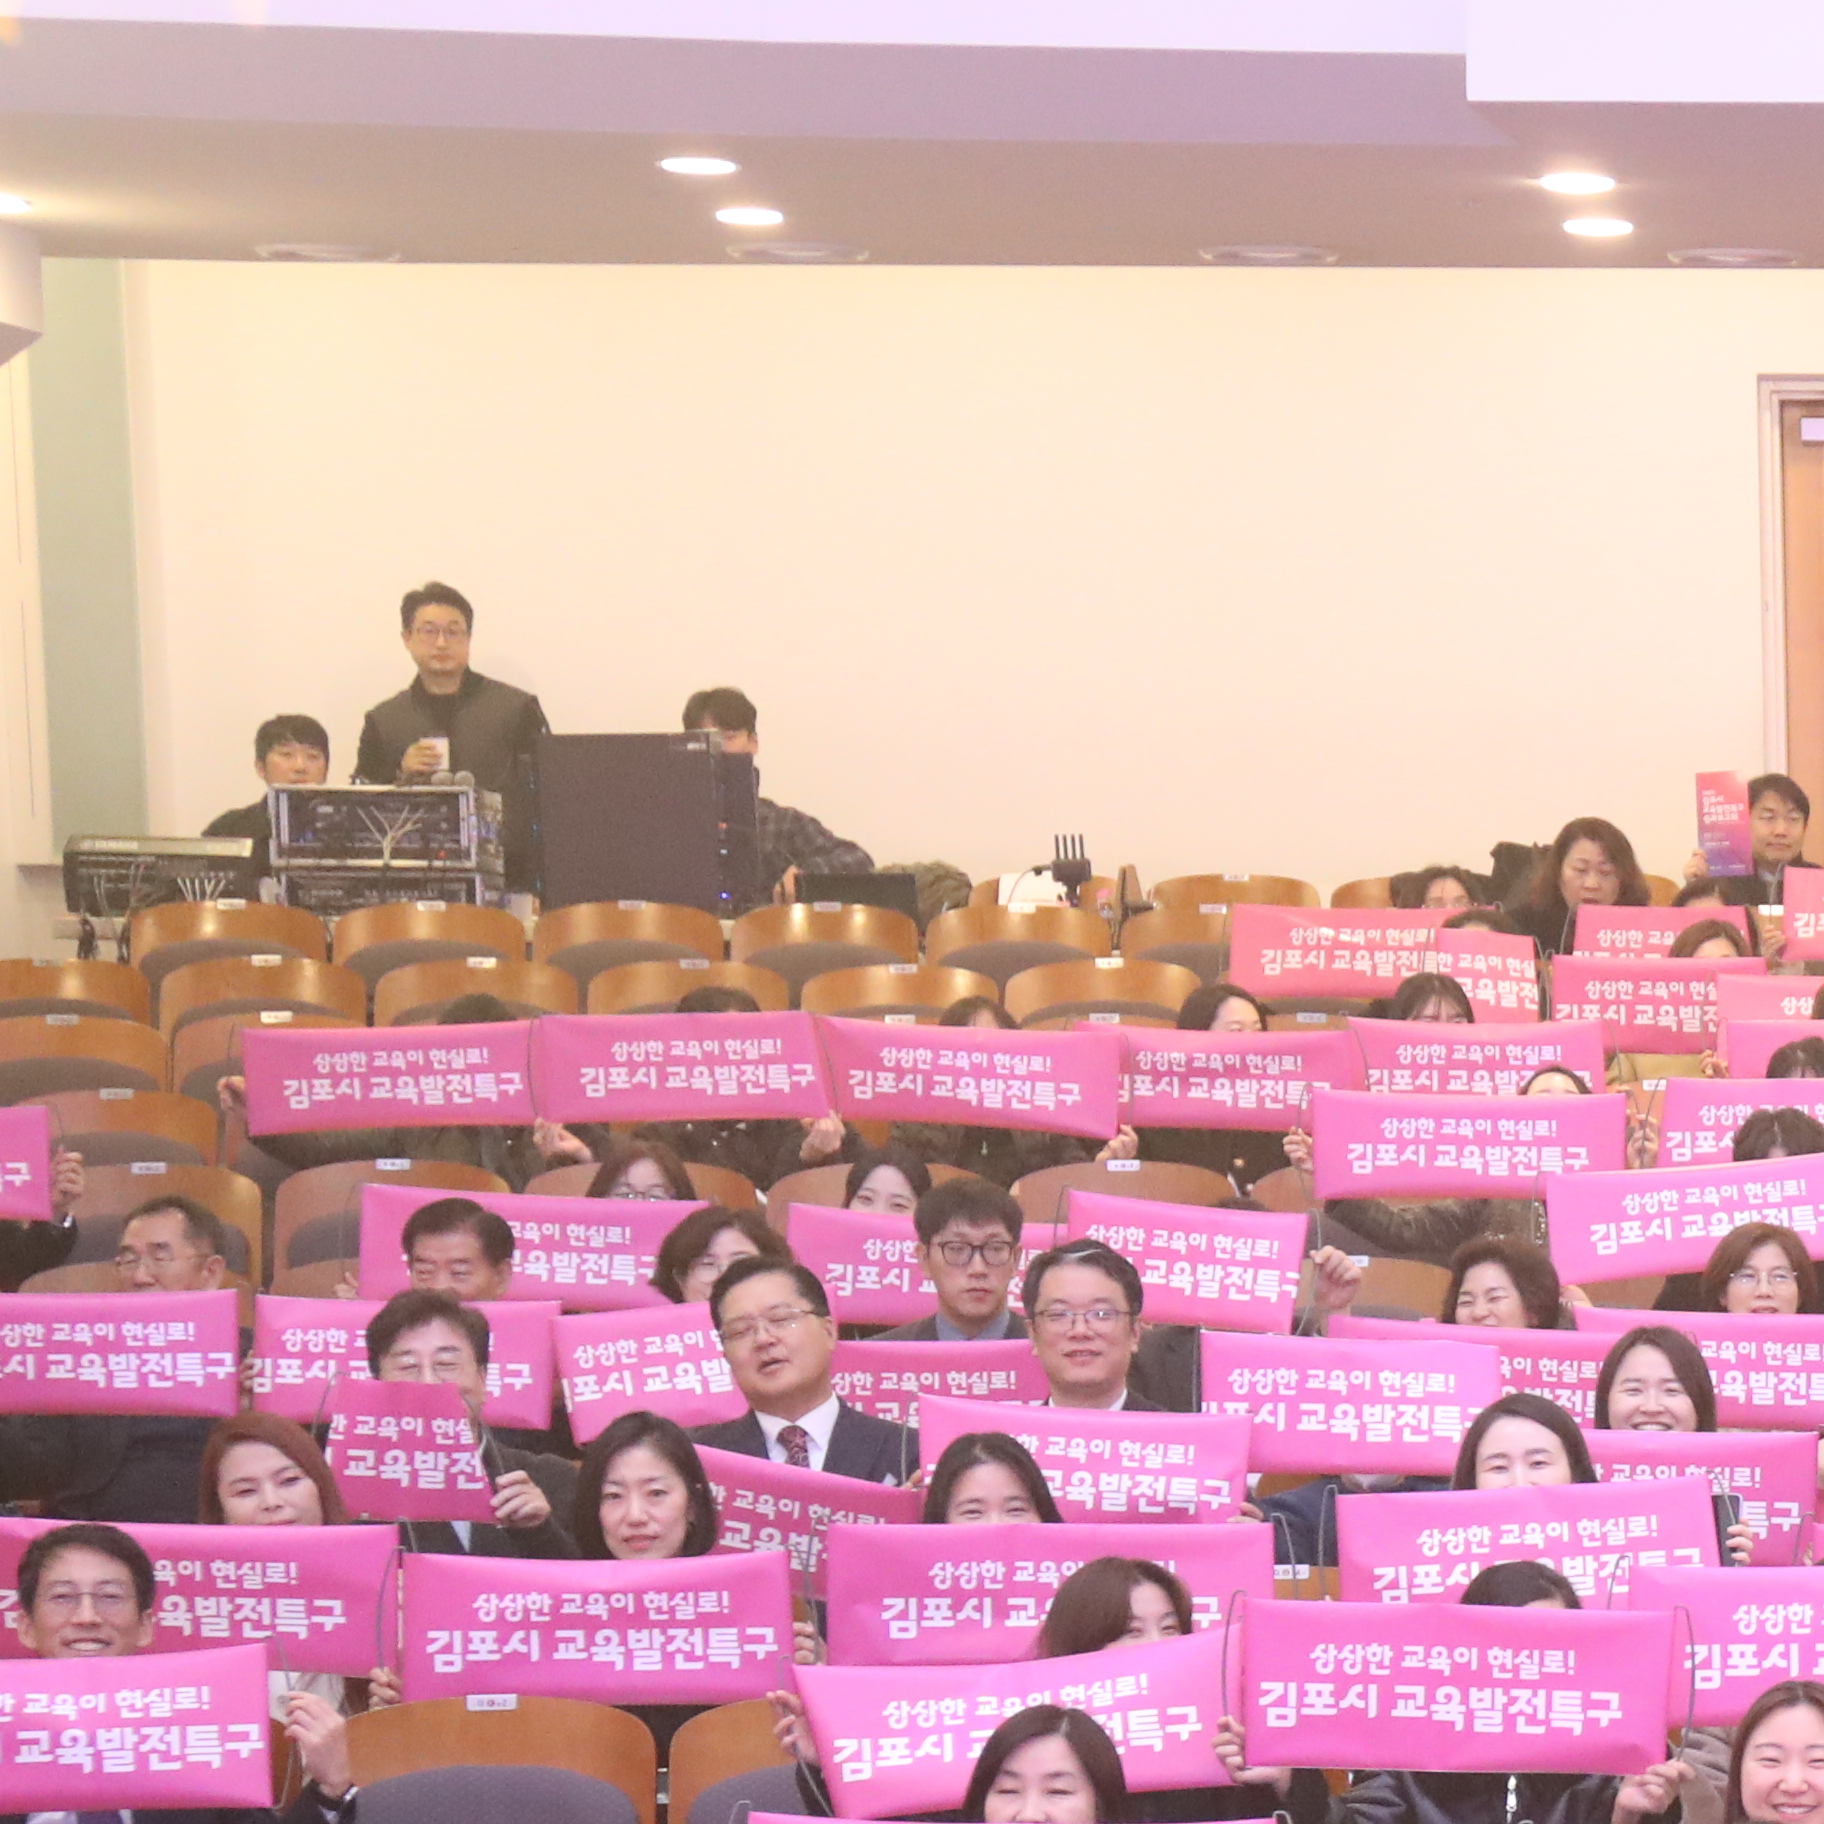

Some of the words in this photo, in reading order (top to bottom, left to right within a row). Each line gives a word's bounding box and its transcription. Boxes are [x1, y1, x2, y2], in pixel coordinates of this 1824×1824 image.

[312, 1050, 368, 1074] 상상한
[372, 1049, 425, 1071] 교육이
[427, 1046, 490, 1071] 현실로!
[879, 1046, 934, 1070] 상상한
[936, 1049, 989, 1072] 교육이
[992, 1052, 1052, 1076] 현실로!
[283, 1077, 362, 1110] 김포시
[369, 1071, 524, 1106] 교육발전특구
[848, 1069, 923, 1100] 김포시
[930, 1074, 1083, 1112] 교육발전특구
[1380, 1117, 1436, 1140] 상상한
[1439, 1118, 1492, 1140] 교육이
[1497, 1118, 1557, 1142] 현실로!
[1346, 1143, 1426, 1175] 김포시
[1433, 1144, 1590, 1177] 교육발전특구
[1621, 1189, 1680, 1216] 상상한
[1684, 1184, 1739, 1208] 교육이
[1742, 1178, 1807, 1205] 현실로!
[1589, 1216, 1673, 1256] 김포시
[471, 1591, 554, 1623] 상상한
[559, 1592, 635, 1621] 교육이
[642, 1590, 730, 1621] 현실로!
[1732, 1602, 1815, 1636] 상상한
[425, 1629, 541, 1673] 김포시
[552, 1626, 779, 1672] 교육발전특구
[1309, 1642, 1394, 1676] 상상한
[1400, 1645, 1479, 1677] 교육이
[1486, 1646, 1576, 1681] 현실로!
[1683, 1642, 1800, 1690] 김포시
[1258, 1681, 1378, 1728] 김포시
[1390, 1684, 1623, 1737] 교육발전특구
